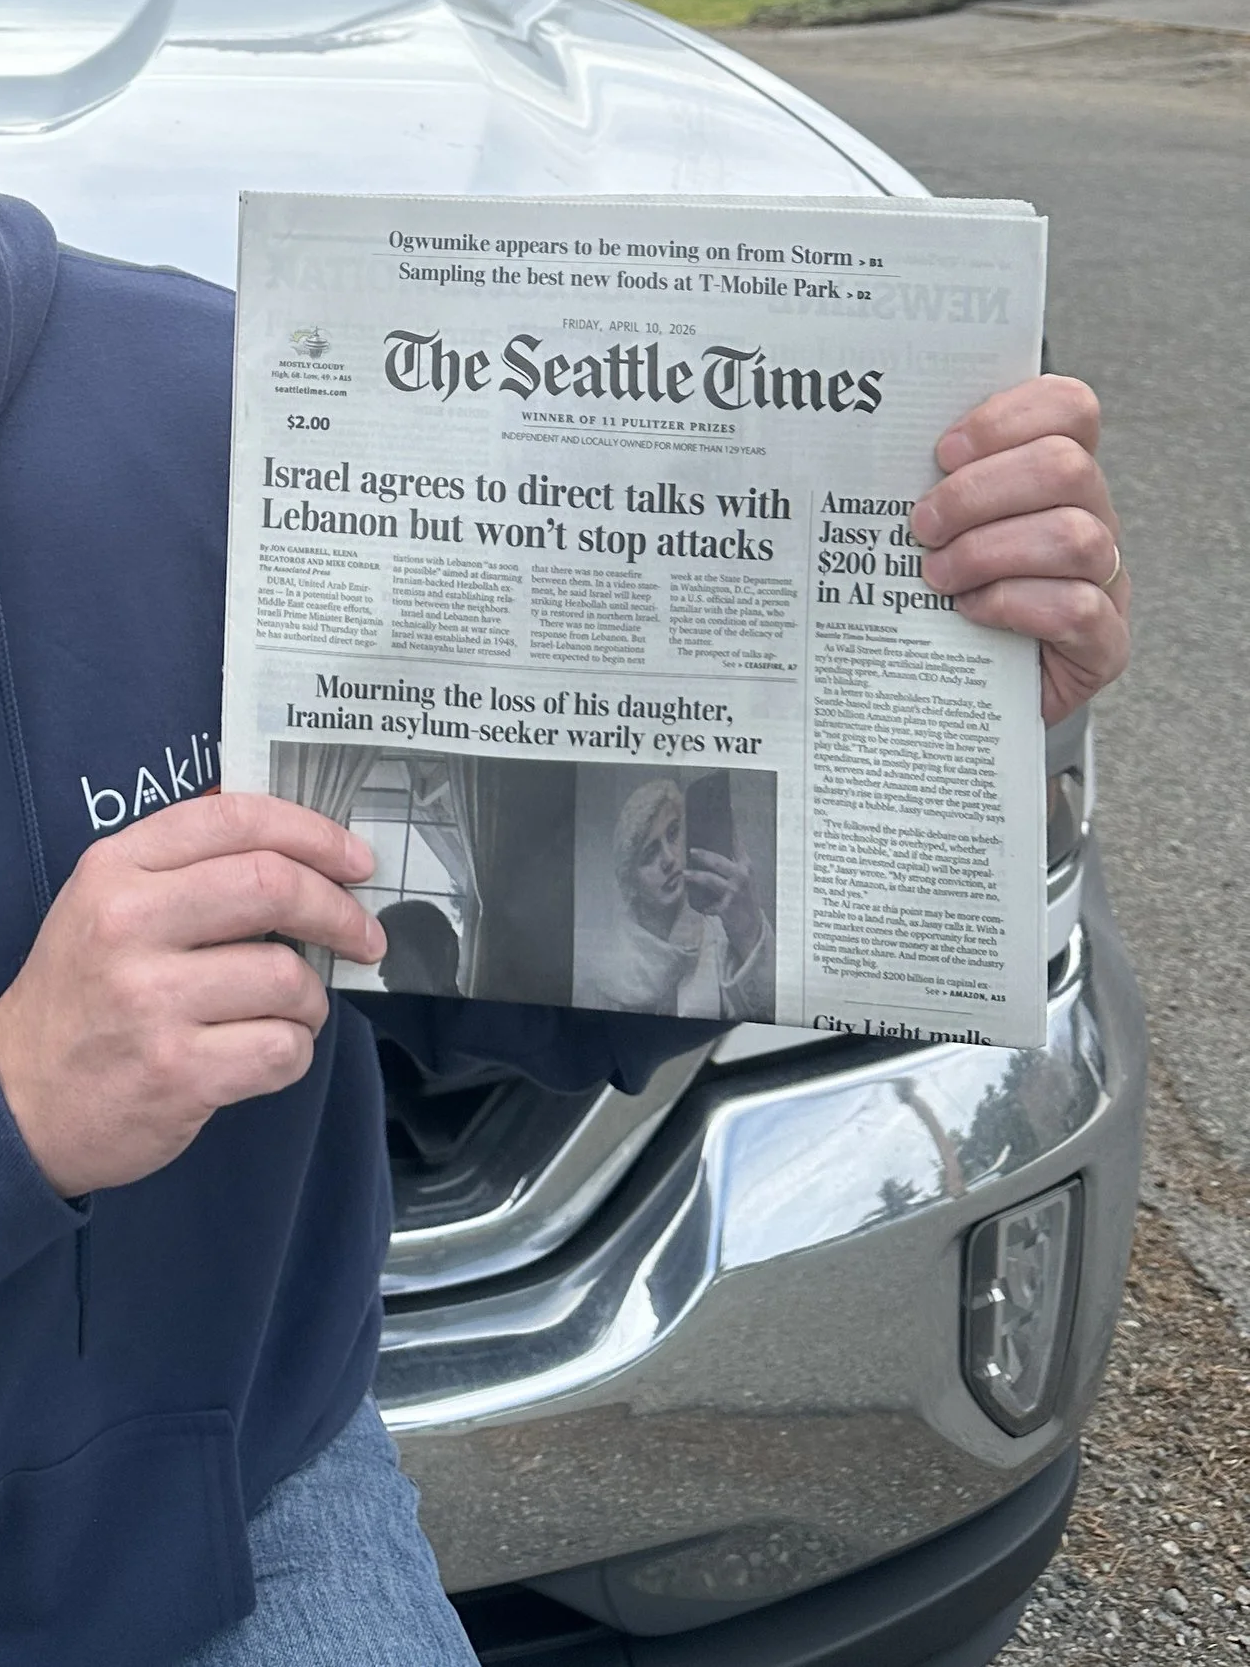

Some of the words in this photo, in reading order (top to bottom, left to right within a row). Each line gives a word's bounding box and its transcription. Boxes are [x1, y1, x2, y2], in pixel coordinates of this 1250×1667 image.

[389, 231, 489, 256] Ogwumike
[495, 241, 567, 260] appears
[574, 238, 592, 257] to
[599, 238, 620, 258] be
[627, 241, 698, 266] moving
[706, 248, 729, 262] on
[737, 243, 784, 264] from
[791, 245, 852, 266] Storm
[869, 258, 883, 268] B1
[399, 262, 484, 290] Sampling
[492, 266, 520, 286] the
[527, 267, 562, 287] best
[571, 275, 607, 289] new
[617, 271, 667, 292] foods
[674, 274, 691, 292] at
[699, 274, 786, 296] T-Mobile
[794, 278, 840, 298] Park
[857, 290, 872, 300] D2
[563, 319, 602, 333] FRIDAY,
[608, 321, 639, 333] APRIL
[645, 322, 661, 336] 10,
[669, 324, 696, 335] 2026
[384, 329, 492, 403] The
[499, 334, 694, 405] Seattle
[702, 346, 885, 415] Times
[275, 386, 347, 397] seattletimes.com
[287, 414, 330, 430] $2.00
[522, 413, 573, 424] WINNER
[579, 416, 595, 426] OF
[602, 417, 615, 427] 11
[621, 418, 684, 430] PULITZER
[690, 422, 736, 433] PRIZES
[502, 433, 558, 444] INDEPENDENT
[560, 436, 579, 445] AND
[580, 437, 618, 447] LOCALLY
[619, 439, 653, 449] OWNED
[653, 441, 671, 450] FOR
[672, 442, 697, 452] MORE
[699, 444, 722, 453] THAN
[725, 445, 739, 454] 129
[740, 446, 766, 455] YEARS
[263, 456, 348, 492] Israel
[361, 472, 463, 504] agrees
[476, 470, 505, 501] to
[518, 472, 612, 508] direct
[626, 479, 704, 514] talks
[717, 486, 791, 519] with
[262, 498, 396, 537] Lebanon
[410, 508, 462, 541] but
[477, 520, 566, 549] won't
[578, 519, 645, 561] stop
[657, 524, 773, 560] attacks
[819, 520, 882, 551] Jassy
[889, 524, 925, 547] de
[818, 548, 876, 575] $200
[817, 580, 840, 603] in
[849, 582, 875, 605] AI
[745, 662, 785, 671] CEASEFIRE,
[316, 676, 434, 710] Mourning
[444, 683, 482, 707] the
[490, 686, 534, 710] loss
[543, 689, 568, 711] of
[574, 690, 608, 714] his
[617, 693, 733, 725] daughter,
[287, 705, 372, 731] Iranian
[381, 713, 558, 742] asylum-seeker
[568, 723, 642, 753] warily
[653, 732, 704, 755] eyes
[714, 736, 762, 753] war
[80, 732, 221, 830] bAkli
[925, 987, 940, 995] See
[950, 990, 988, 1001] AMAZON,
[991, 994, 1006, 1002] A15
